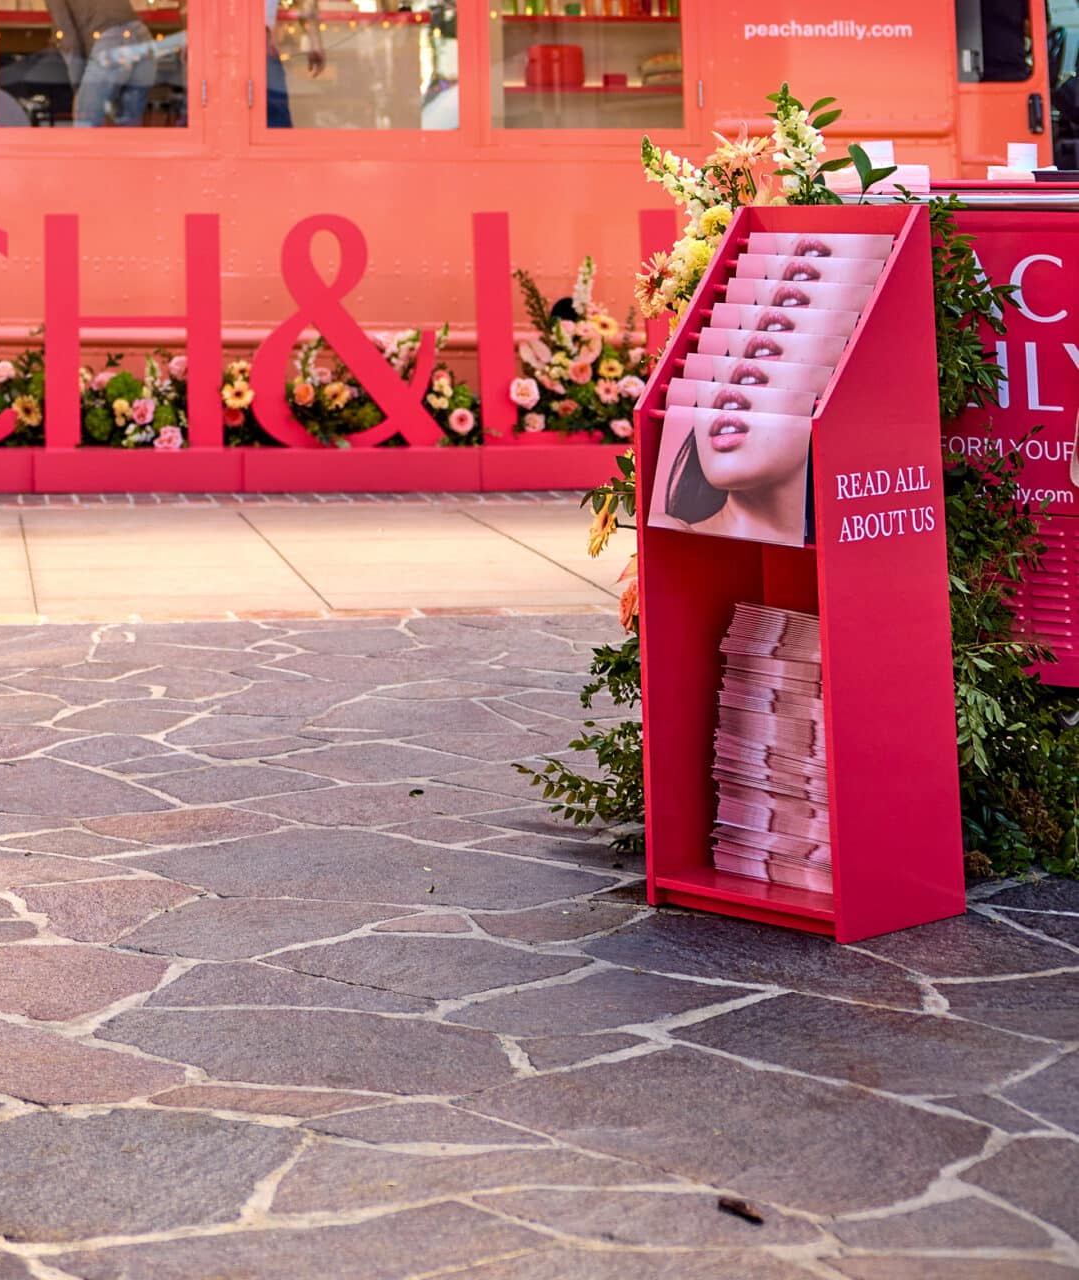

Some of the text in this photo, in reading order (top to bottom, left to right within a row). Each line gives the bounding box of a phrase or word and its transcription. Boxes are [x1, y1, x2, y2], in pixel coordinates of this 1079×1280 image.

[744, 20, 913, 41] peachandlily.com
[835, 465, 931, 500] READ ALL
[839, 506, 935, 543] ABOUT US
